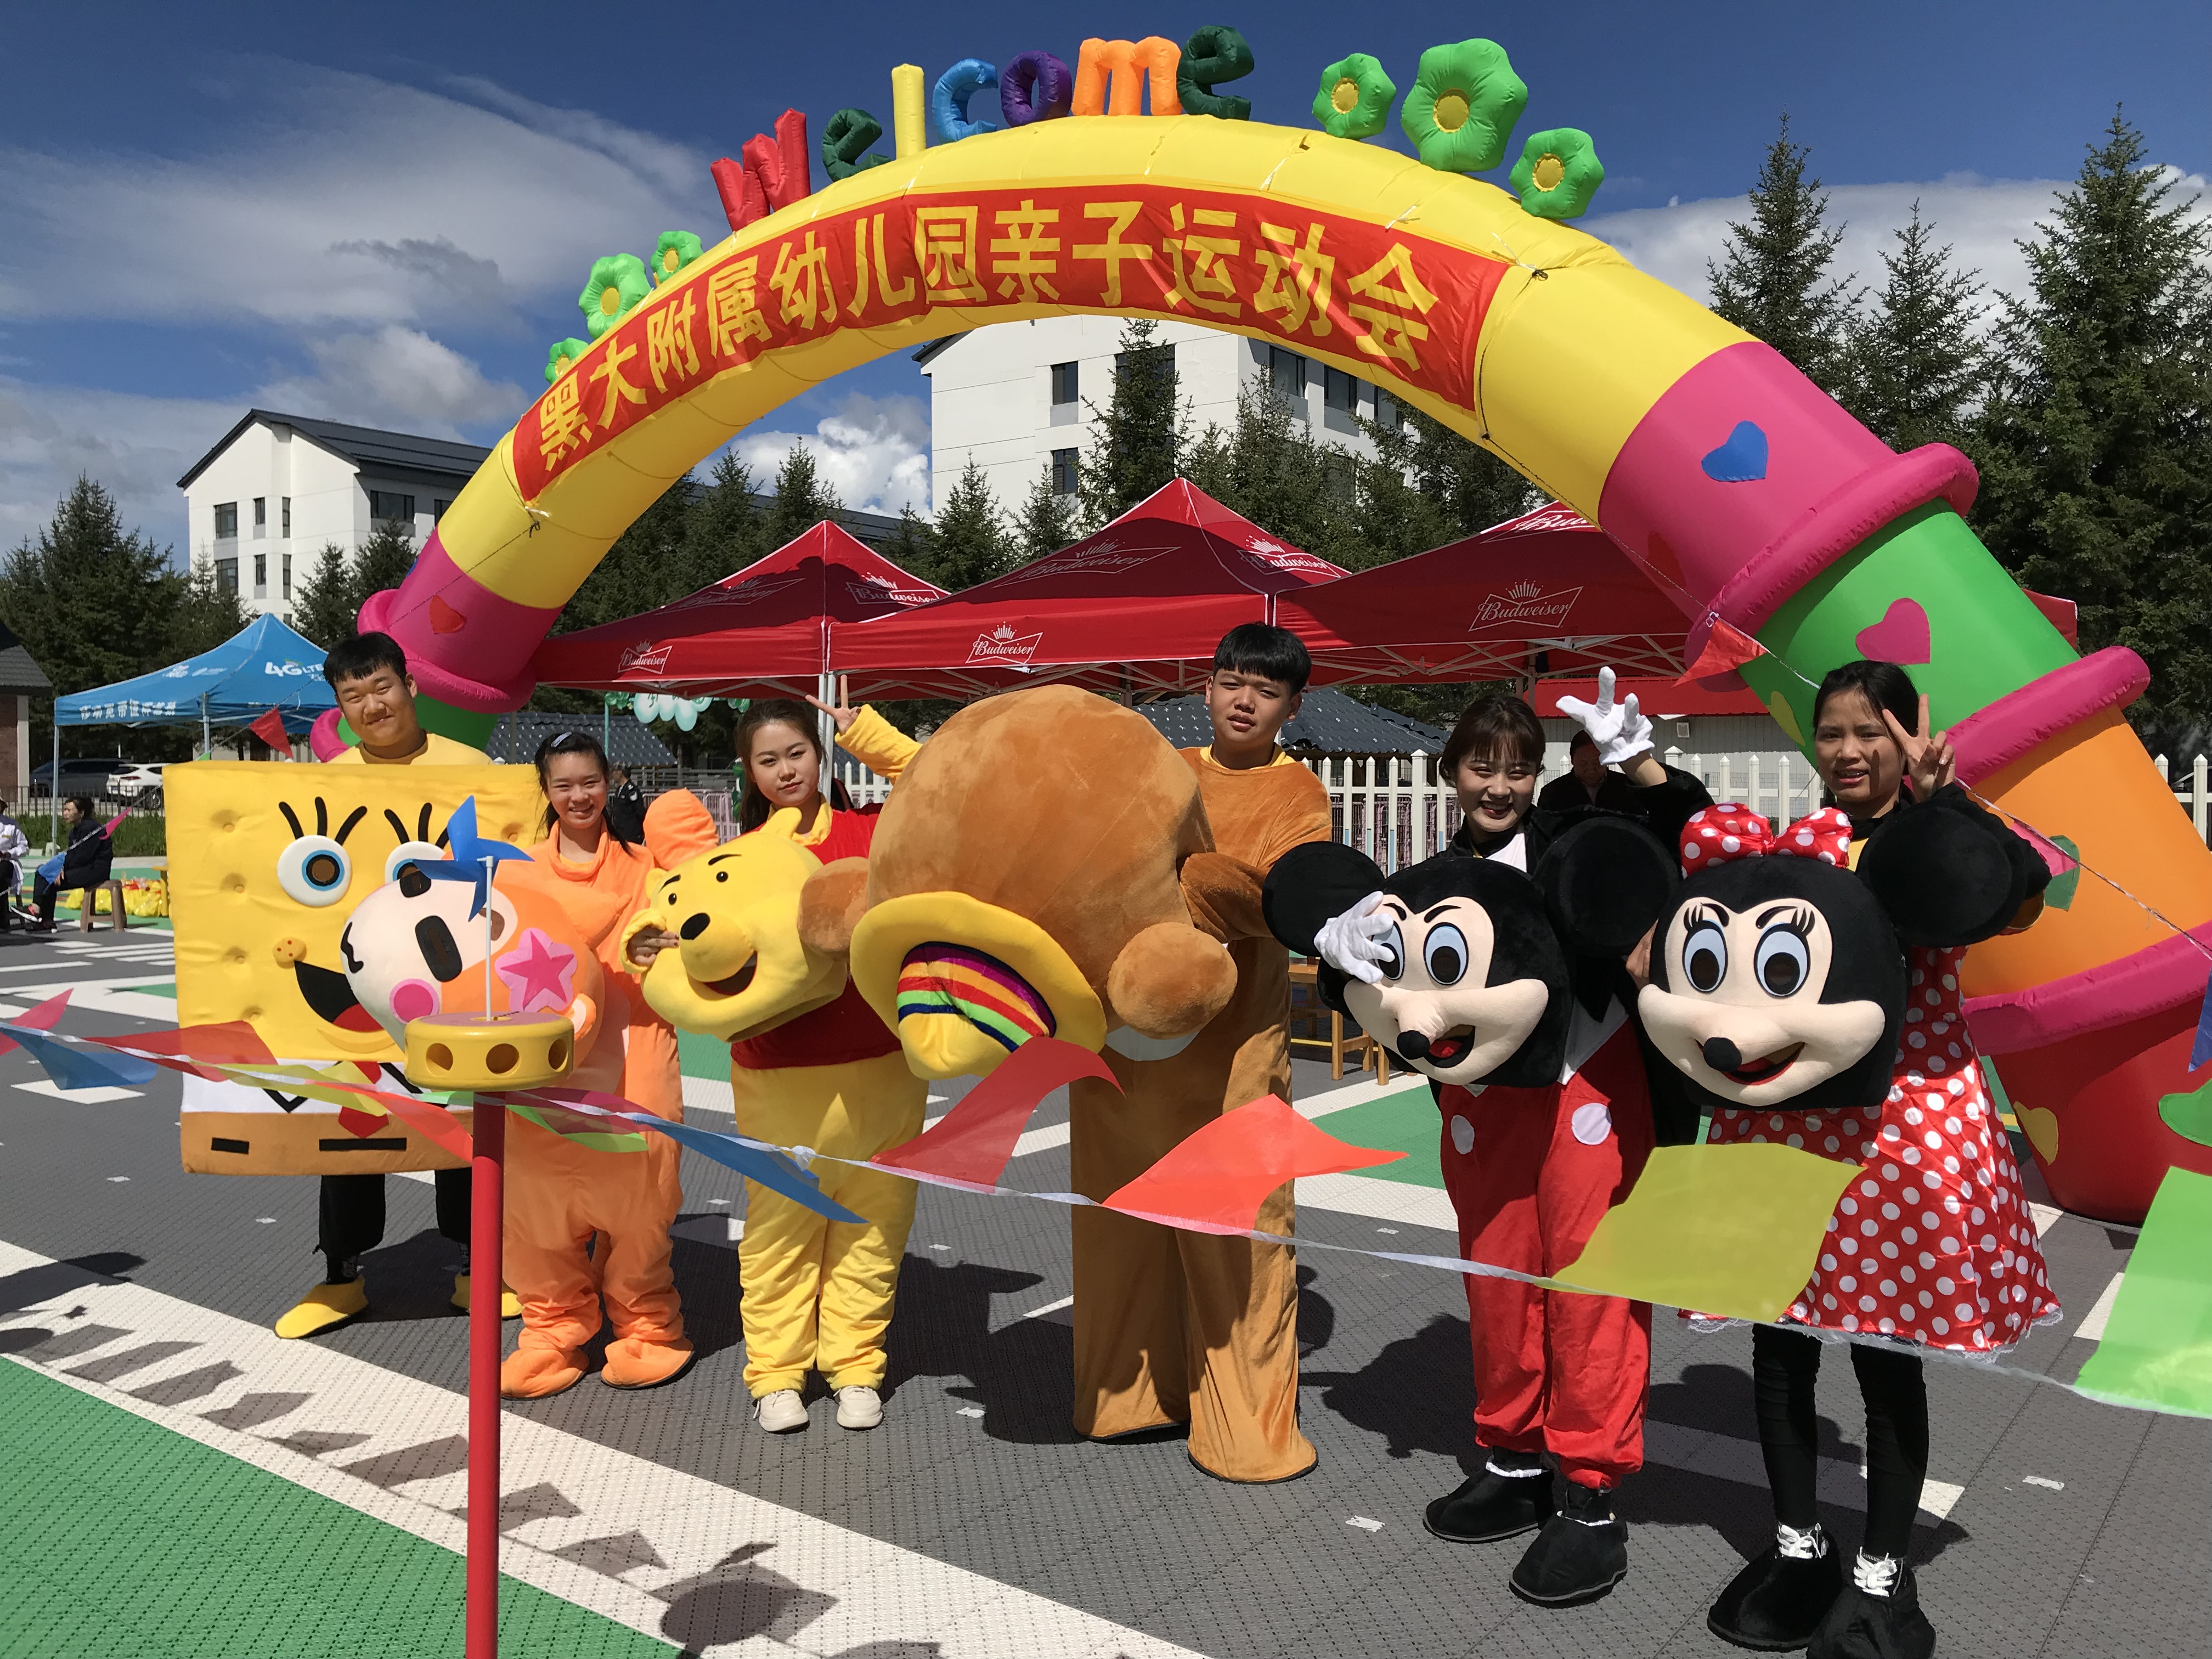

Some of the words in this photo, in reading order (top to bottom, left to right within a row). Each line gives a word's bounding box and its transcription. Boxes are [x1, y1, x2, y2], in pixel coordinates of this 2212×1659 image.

[539, 198, 1440, 471] 黑大附属幼儿园亲子运动会
[1240, 554, 1328, 569] Budweiser
[1478, 601, 1570, 621] Budweiser
[973, 640, 1034, 656] Budweiser
[620, 653, 666, 667] Budweiser
